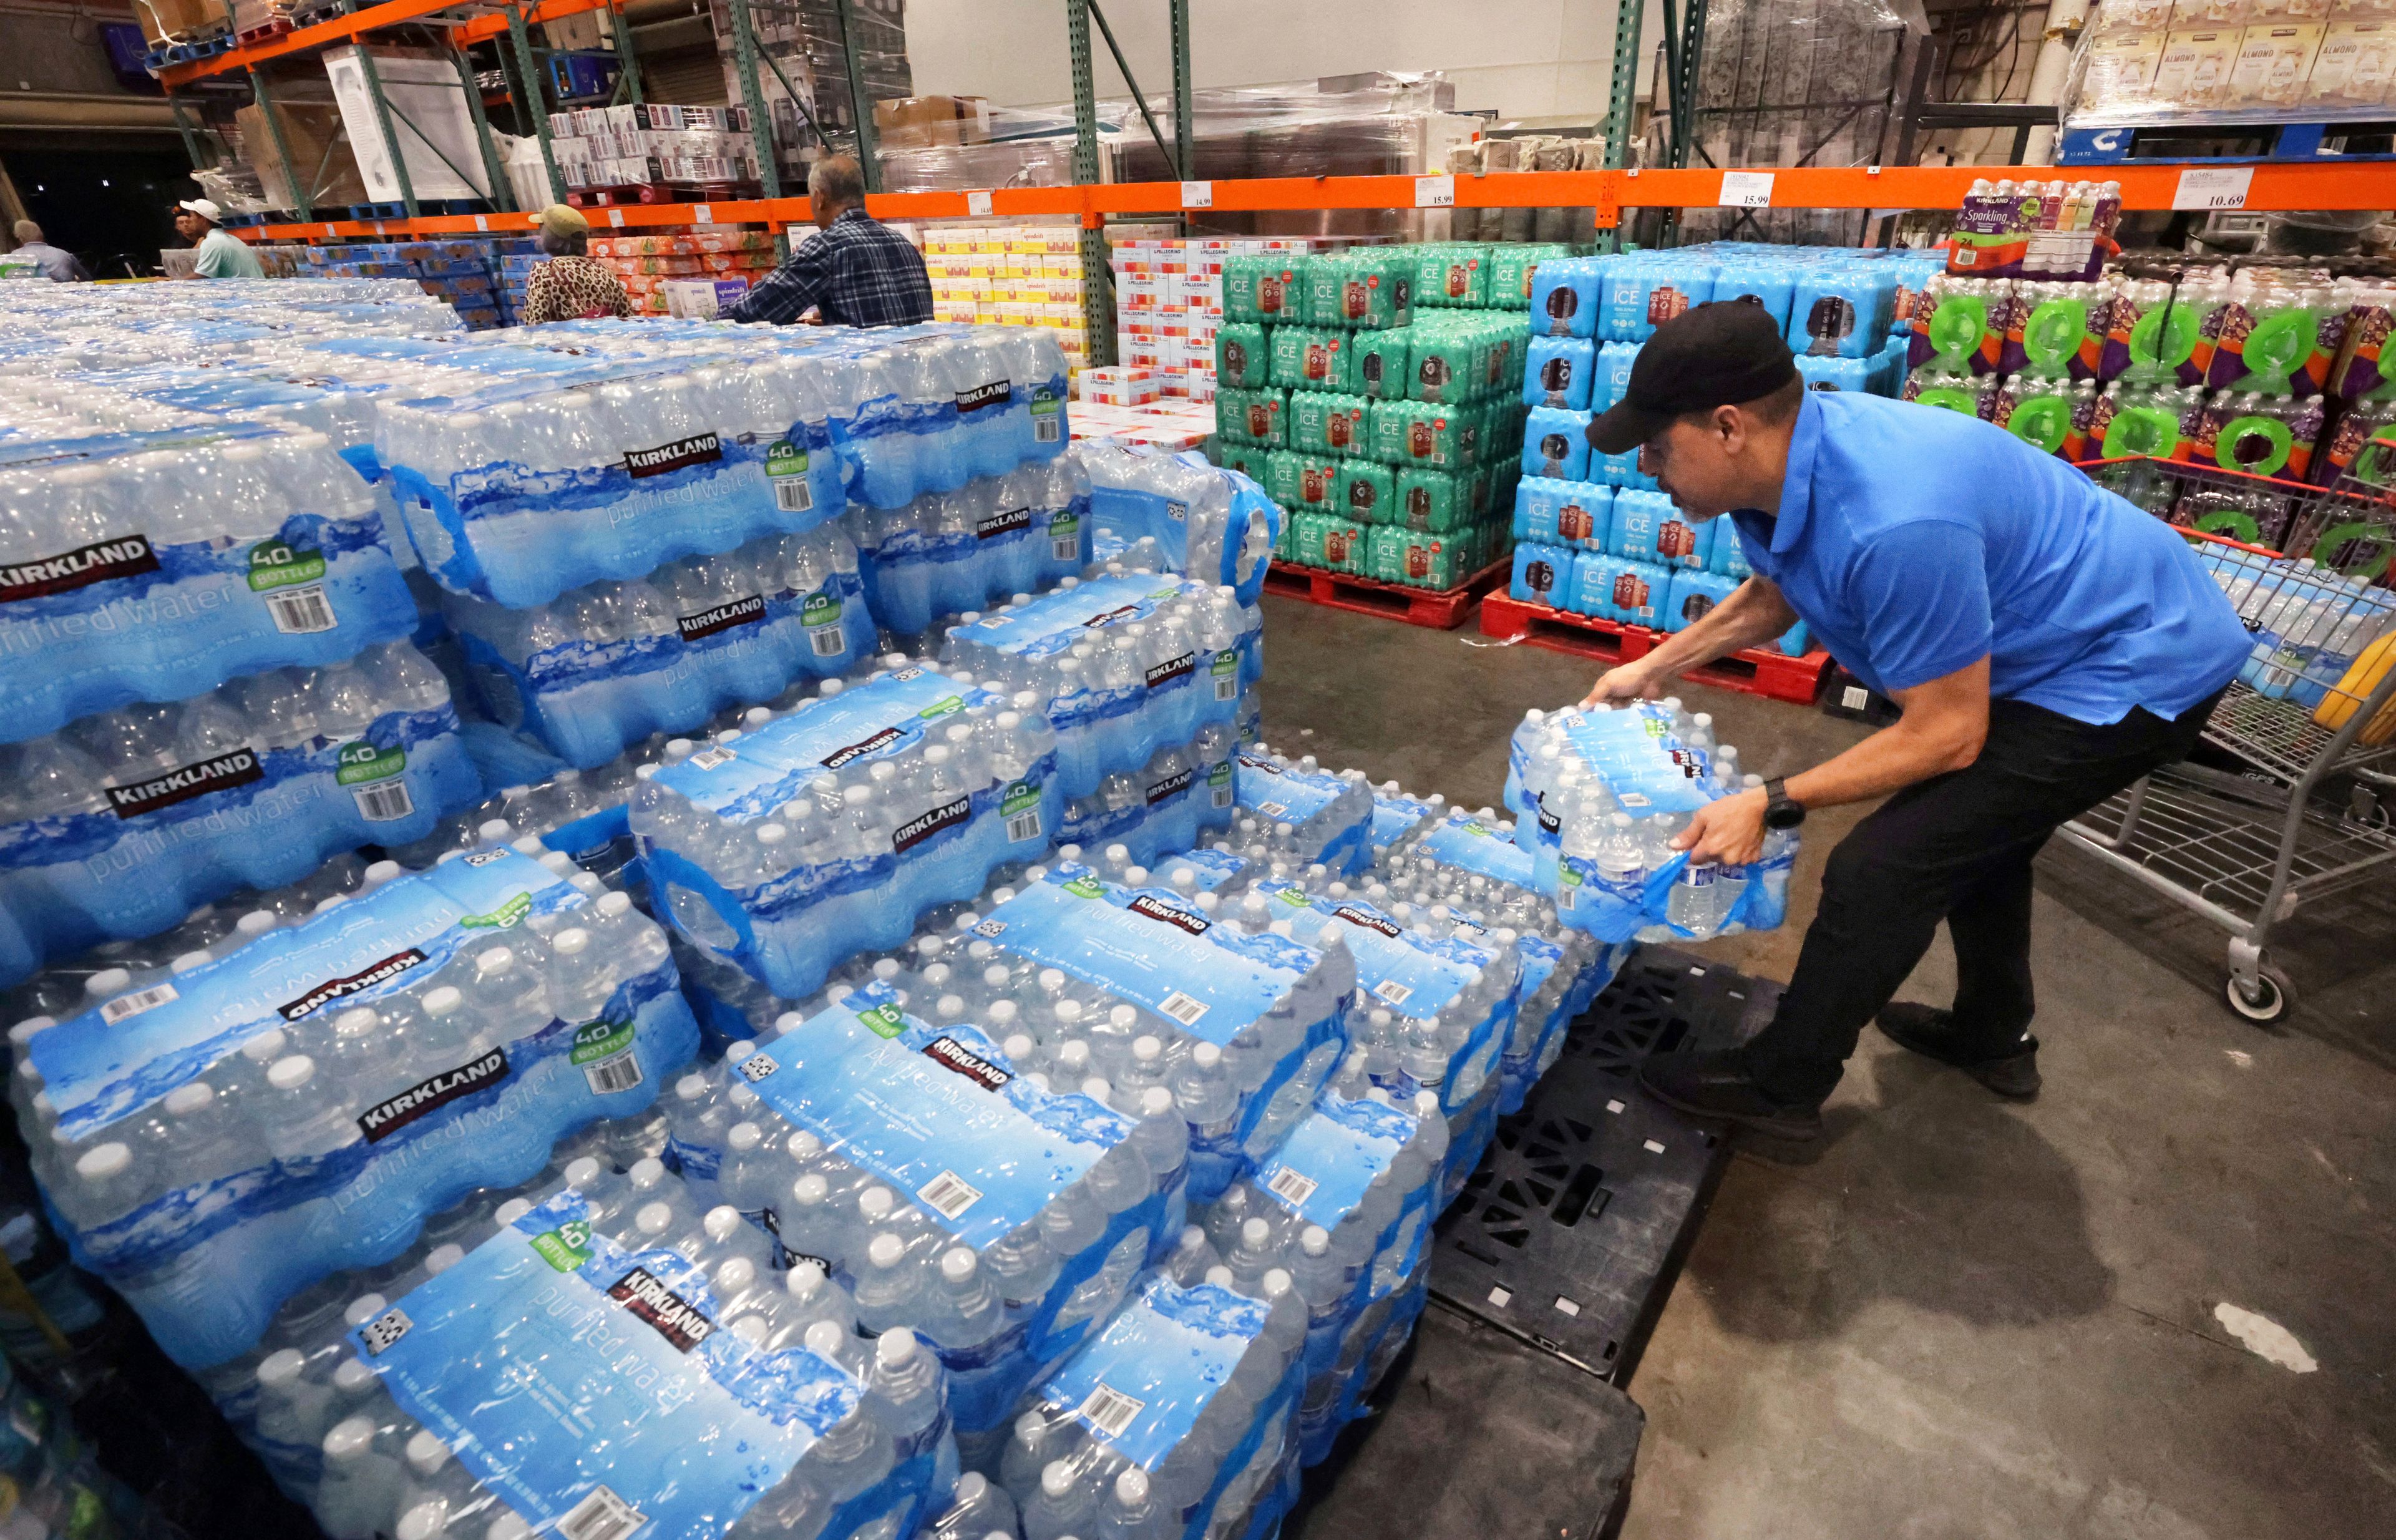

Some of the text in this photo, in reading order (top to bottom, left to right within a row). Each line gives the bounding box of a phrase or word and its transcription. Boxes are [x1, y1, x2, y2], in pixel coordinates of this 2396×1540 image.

[2241, 49, 2274, 58] ALMOND
[2322, 44, 2357, 54] ALMOND
[2165, 54, 2196, 62] ALMOND
[1434, 195, 1452, 204] 15.99
[1743, 195, 1768, 205] 15.99
[2208, 195, 2244, 207] 10.69
[1967, 210, 2008, 224] Sparkling
[1023, 233, 1044, 241] spindrift
[1961, 238, 1972, 246] 24
[1421, 268, 1439, 279] ICE
[1496, 270, 1515, 281] ICE
[718, 285, 746, 297] spindrift
[1026, 283, 1046, 291] spindrift
[1230, 280, 1249, 293] ICE
[1314, 285, 1334, 298] ICE
[1614, 290, 1640, 305] ICE
[1277, 345, 1296, 358] ICE
[957, 382, 1009, 404] KIRKLAND
[1034, 391, 1051, 401] 40
[1223, 405, 1239, 417] ICE
[1299, 414, 1319, 427] ICE
[1378, 422, 1400, 436] ICE
[630, 436, 717, 467] KIRKLAND
[768, 445, 793, 459] 40
[1275, 469, 1293, 482] ICE
[606, 470, 756, 529] purified water
[1528, 502, 1551, 517] ICE
[1567, 509, 1579, 517] ICE
[1053, 514, 1069, 524] 40
[1625, 517, 1649, 533] ICE
[1668, 524, 1680, 532] ICE
[1300, 530, 1317, 543] ICE
[252, 546, 293, 566] 40
[1377, 544, 1397, 557] ICE
[255, 563, 323, 585] BOTTLES
[1582, 569, 1607, 585] ICE
[1624, 578, 1635, 586] ICE
[123, 582, 235, 626] water
[804, 595, 827, 610] 40
[681, 597, 762, 631] KIRKLAND
[1215, 653, 1232, 663] 40
[340, 746, 376, 764] 40
[829, 731, 902, 768] KIRKLAND
[343, 757, 402, 781] BOTTLES
[1212, 764, 1229, 774] 40
[1240, 754, 1282, 773] IRKAND
[114, 754, 252, 804] KIRKLAND
[1004, 785, 1027, 801] 40
[895, 800, 968, 844] KIRKLAND
[83, 782, 323, 884] purified water
[1077, 875, 1098, 889] 40
[498, 903, 531, 928] 40
[1136, 896, 1207, 930] KIRKLAND
[1078, 905, 1154, 938] purfied
[1340, 907, 1399, 935] KIRKLAND
[290, 954, 421, 1018] KIRKLAND
[877, 1003, 899, 1024] 40
[862, 1011, 897, 1036] BOTTLES
[575, 1025, 611, 1044] 40
[577, 1027, 633, 1059] BOTTLES
[933, 1038, 1008, 1084] KIRKLAND
[364, 1053, 502, 1129] KIRKLAND
[331, 1063, 558, 1216] purified water
[560, 1221, 586, 1248] 40
[625, 1270, 709, 1342] KIRKLAND
[531, 1285, 623, 1358] purified
